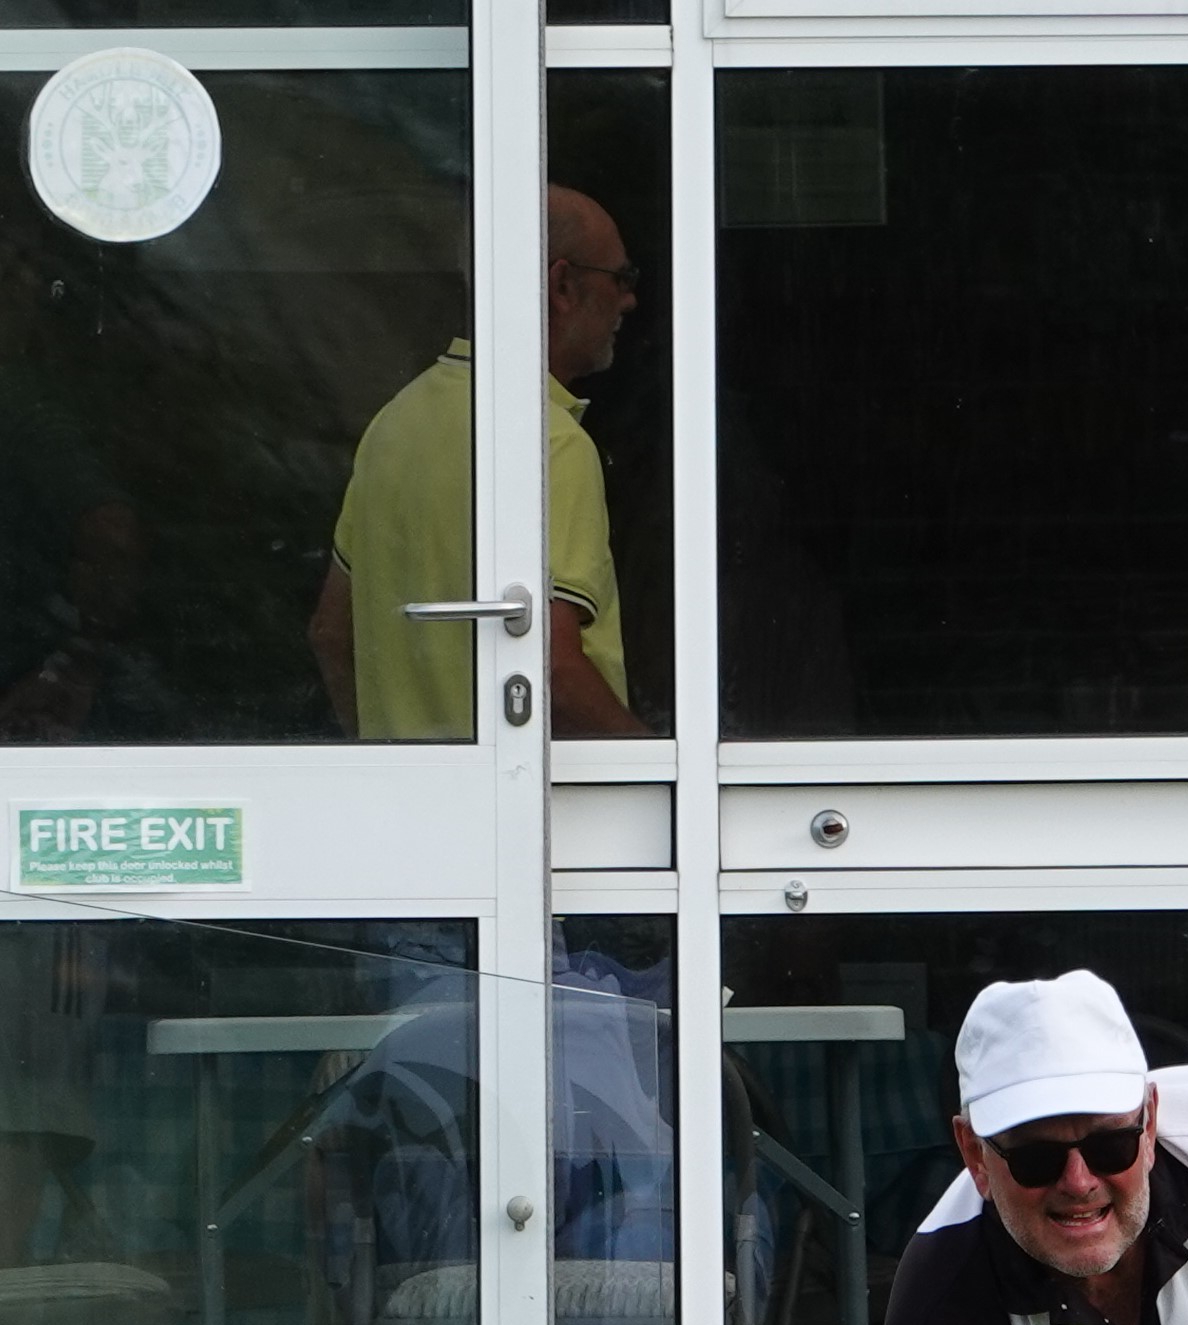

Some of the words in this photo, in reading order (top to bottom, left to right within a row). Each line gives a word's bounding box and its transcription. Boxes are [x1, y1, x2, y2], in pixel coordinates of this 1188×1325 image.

[29, 817, 127, 853] FIRE
[140, 816, 234, 851] EXIT
[29, 861, 66, 872] Please
[69, 861, 96, 873] keep
[98, 860, 118, 871] this
[120, 860, 146, 871] door
[148, 860, 198, 871] unlocked
[200, 860, 233, 871] whilst
[85, 873, 109, 884] club
